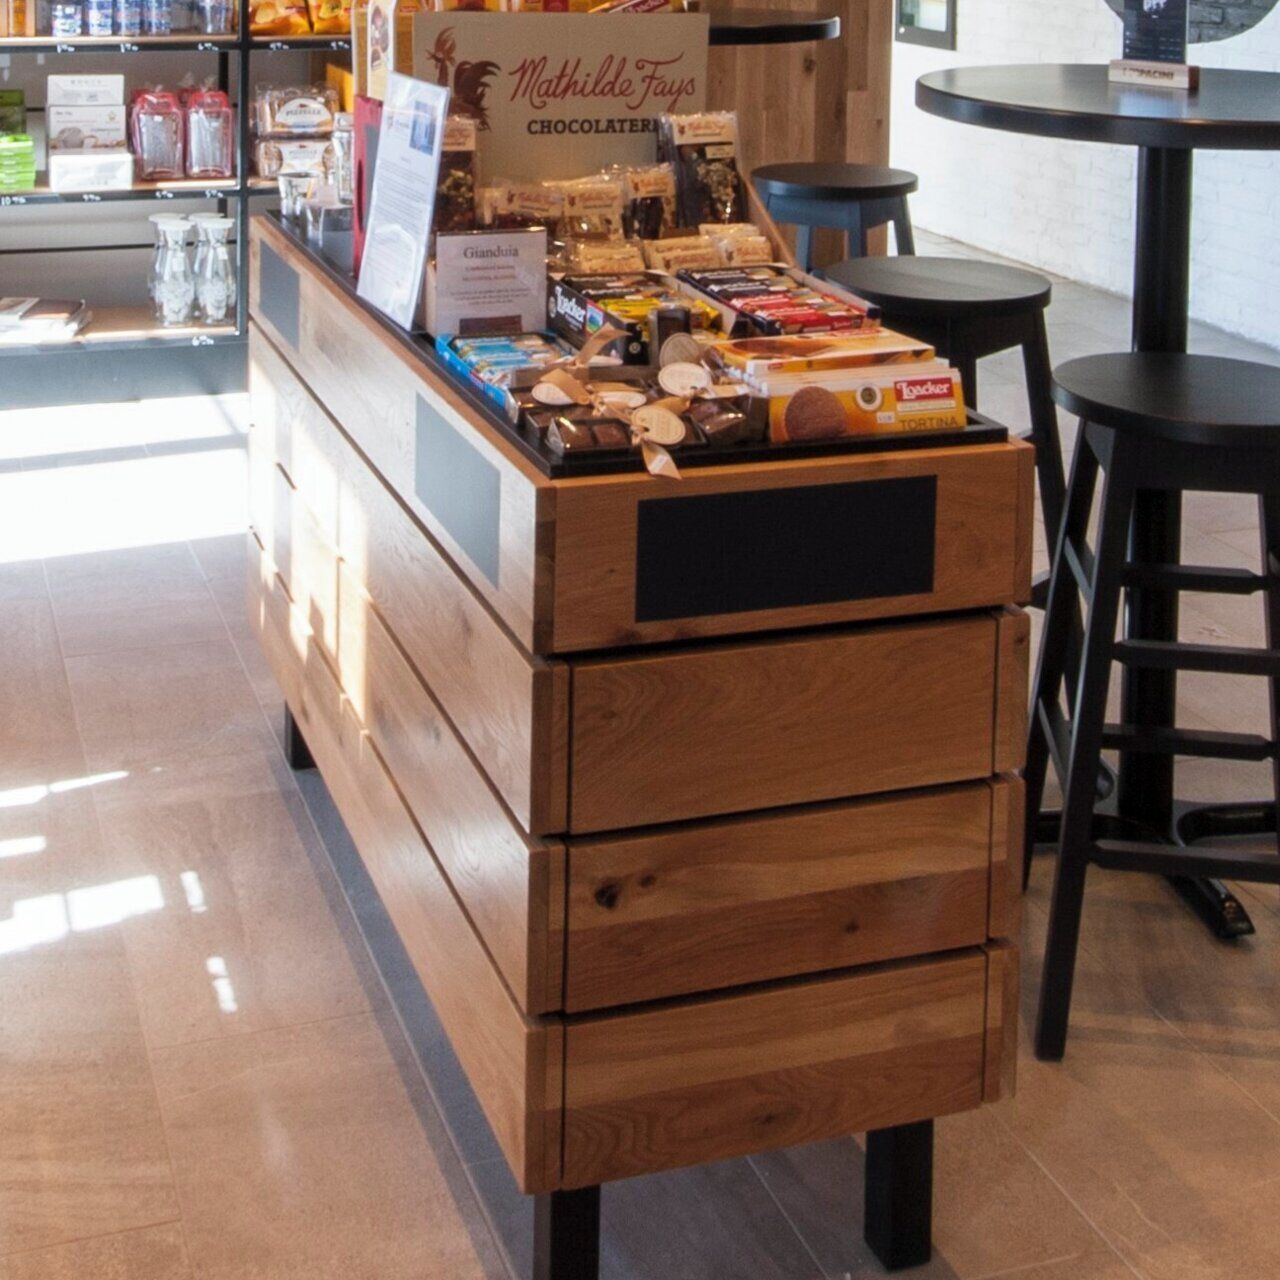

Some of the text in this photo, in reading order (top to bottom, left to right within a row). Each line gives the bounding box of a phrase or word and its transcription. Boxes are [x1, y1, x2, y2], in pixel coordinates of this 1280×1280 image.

[508, 51, 696, 113] Mathilde Fays
[463, 244, 520, 260] Gianduia
[554, 284, 587, 323] Loacker
[896, 380, 951, 400] Loacker
[900, 416, 959, 432] TORTINA
